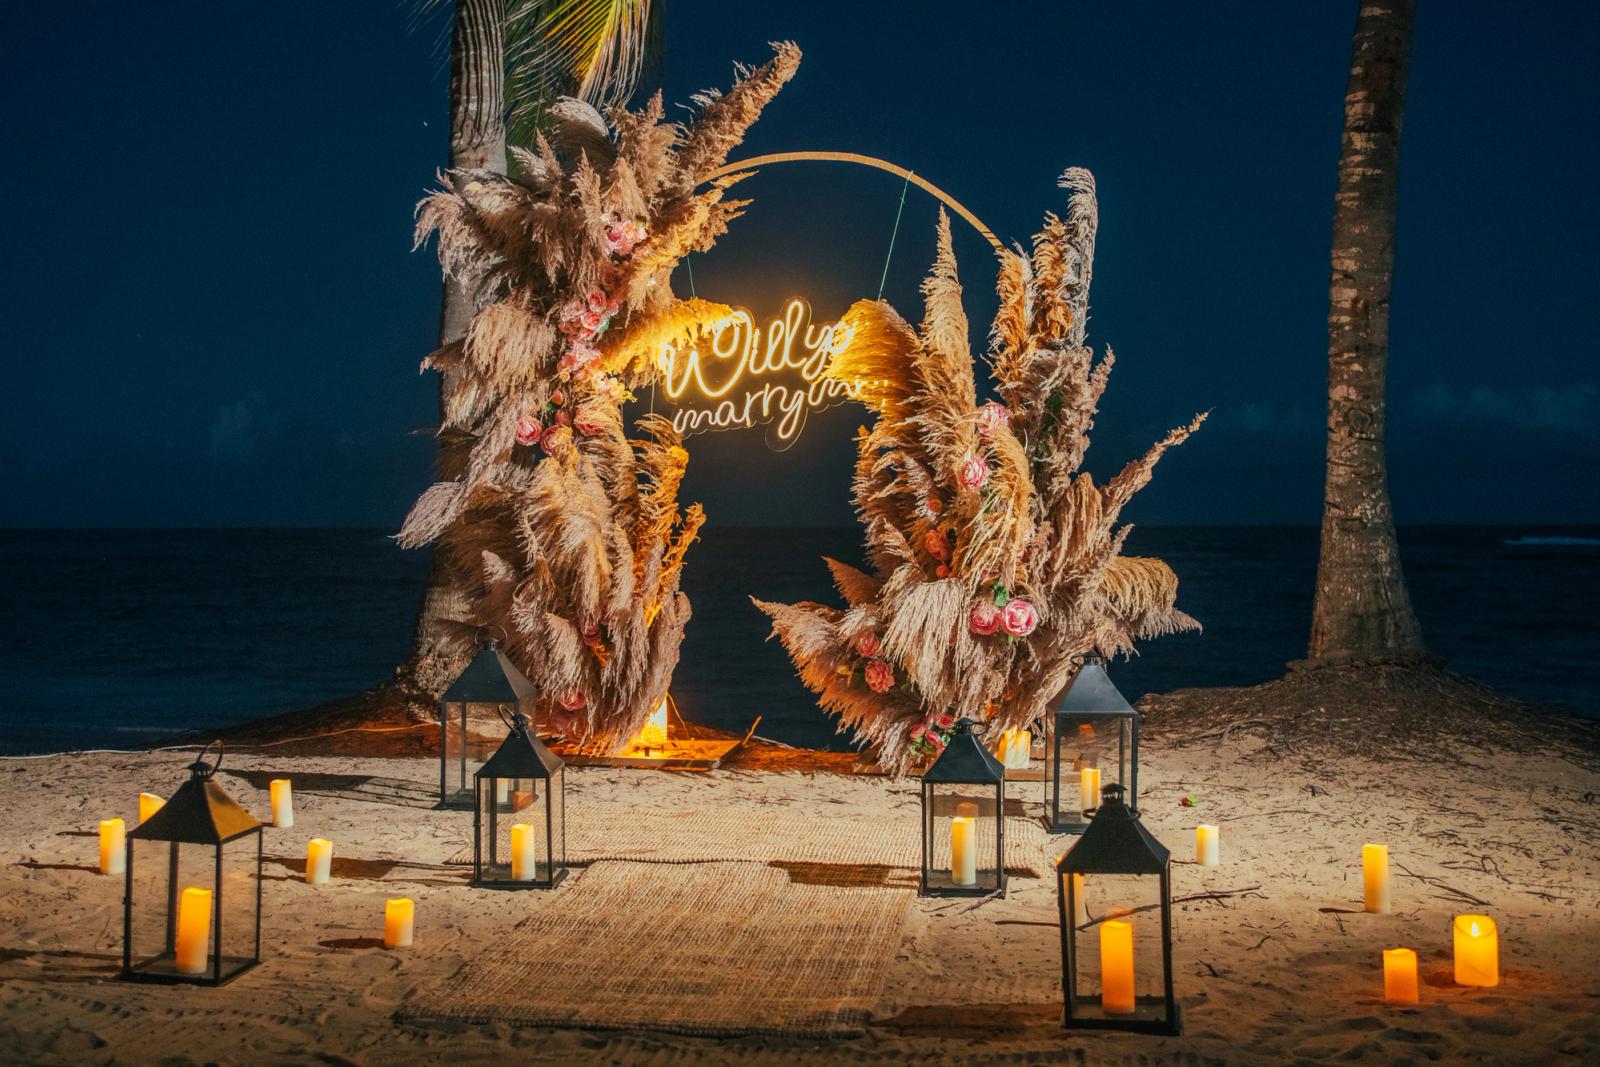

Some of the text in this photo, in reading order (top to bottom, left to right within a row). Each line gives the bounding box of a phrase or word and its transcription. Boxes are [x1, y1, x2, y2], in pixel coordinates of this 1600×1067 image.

[661, 300, 856, 398] Will yo
[673, 376, 864, 439] marry m
